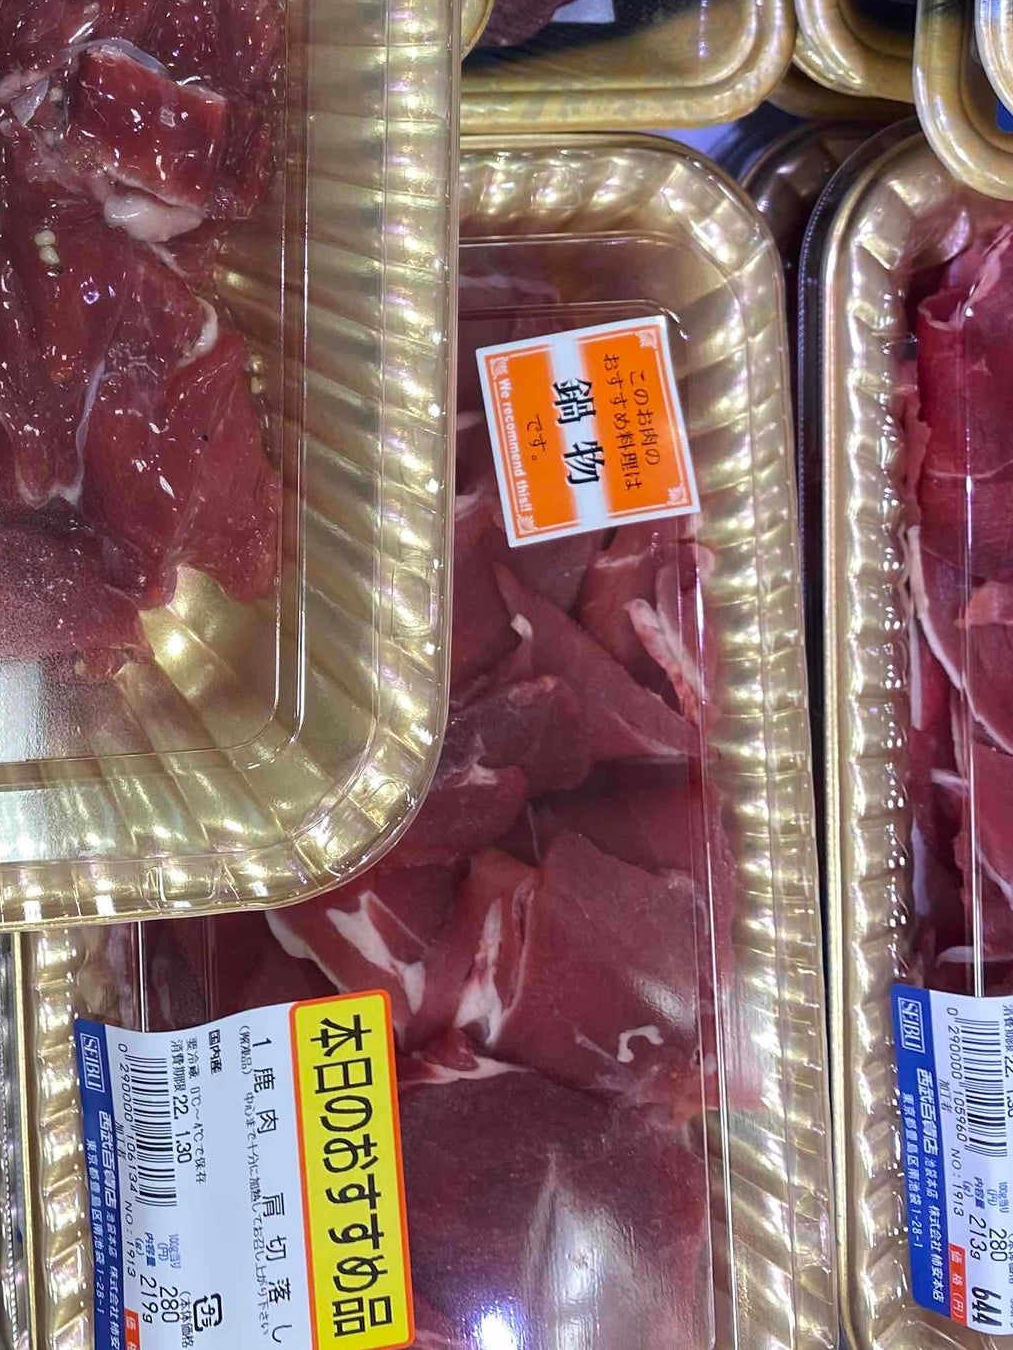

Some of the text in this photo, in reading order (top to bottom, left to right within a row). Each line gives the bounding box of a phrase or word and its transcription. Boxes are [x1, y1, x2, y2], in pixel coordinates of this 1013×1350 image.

[527, 413, 546, 461] です。
[552, 377, 605, 485] 鍋物
[604, 353, 643, 491] おすすめ料理は
[629, 370, 661, 466] このお肉の
[498, 378, 533, 512] We recommend this!!
[209, 1029, 222, 1074] 国内産
[900, 1001, 923, 1052] SEIBU
[947, 1025, 963, 1080] 290000
[82, 1036, 102, 1091] SEIBU
[170, 1040, 186, 1092] 消費期限
[187, 1037, 200, 1078] 要冷蔵
[120, 1063, 134, 1122] 290000
[917, 1068, 937, 1156] 西武百貨店
[952, 1091, 968, 1142] 105960
[99, 1111, 117, 1209] 西武百貨店
[126, 1135, 138, 1193] 106134
[310, 1014, 393, 1337] 本日のおすすめ品
[911, 1209, 923, 1248] 1-28-1
[969, 1214, 987, 1261] 213g
[989, 1229, 1008, 1262] 280
[140, 1274, 159, 1324] 219g
[160, 1286, 180, 1323] 280
[972, 1287, 1002, 1327] 644
